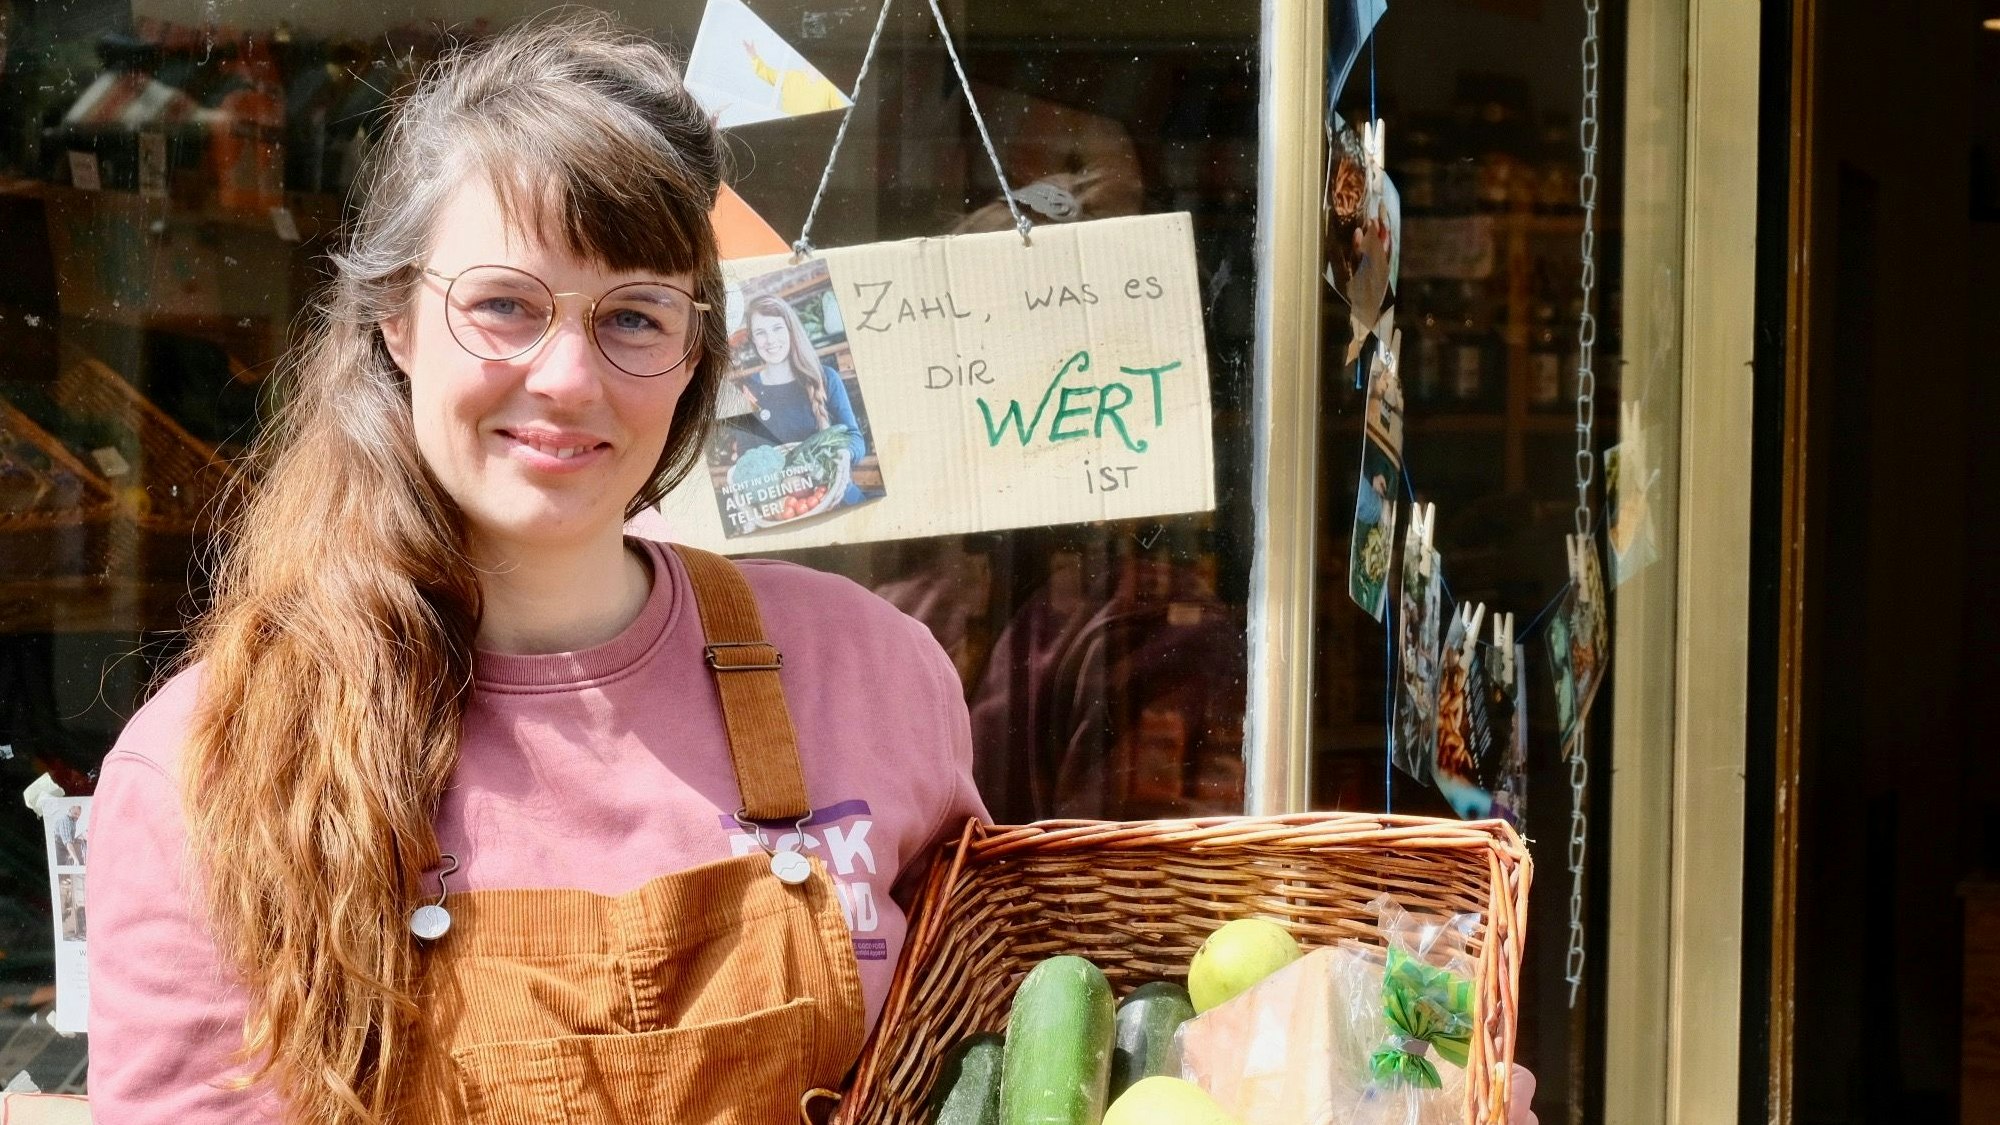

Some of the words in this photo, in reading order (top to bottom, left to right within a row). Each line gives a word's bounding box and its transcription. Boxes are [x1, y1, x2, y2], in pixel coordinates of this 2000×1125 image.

[854, 280, 991, 332] ZAHL,
[1025, 284, 1099, 311] WAS
[976, 350, 1181, 453] WERT
[722, 480, 750, 495] NICHT
[751, 477, 761, 487] IN
[763, 472, 780, 484] DIE
[726, 492, 754, 511] AUF
[757, 476, 814, 502] DEINEN
[728, 500, 786, 526] TELLER!
